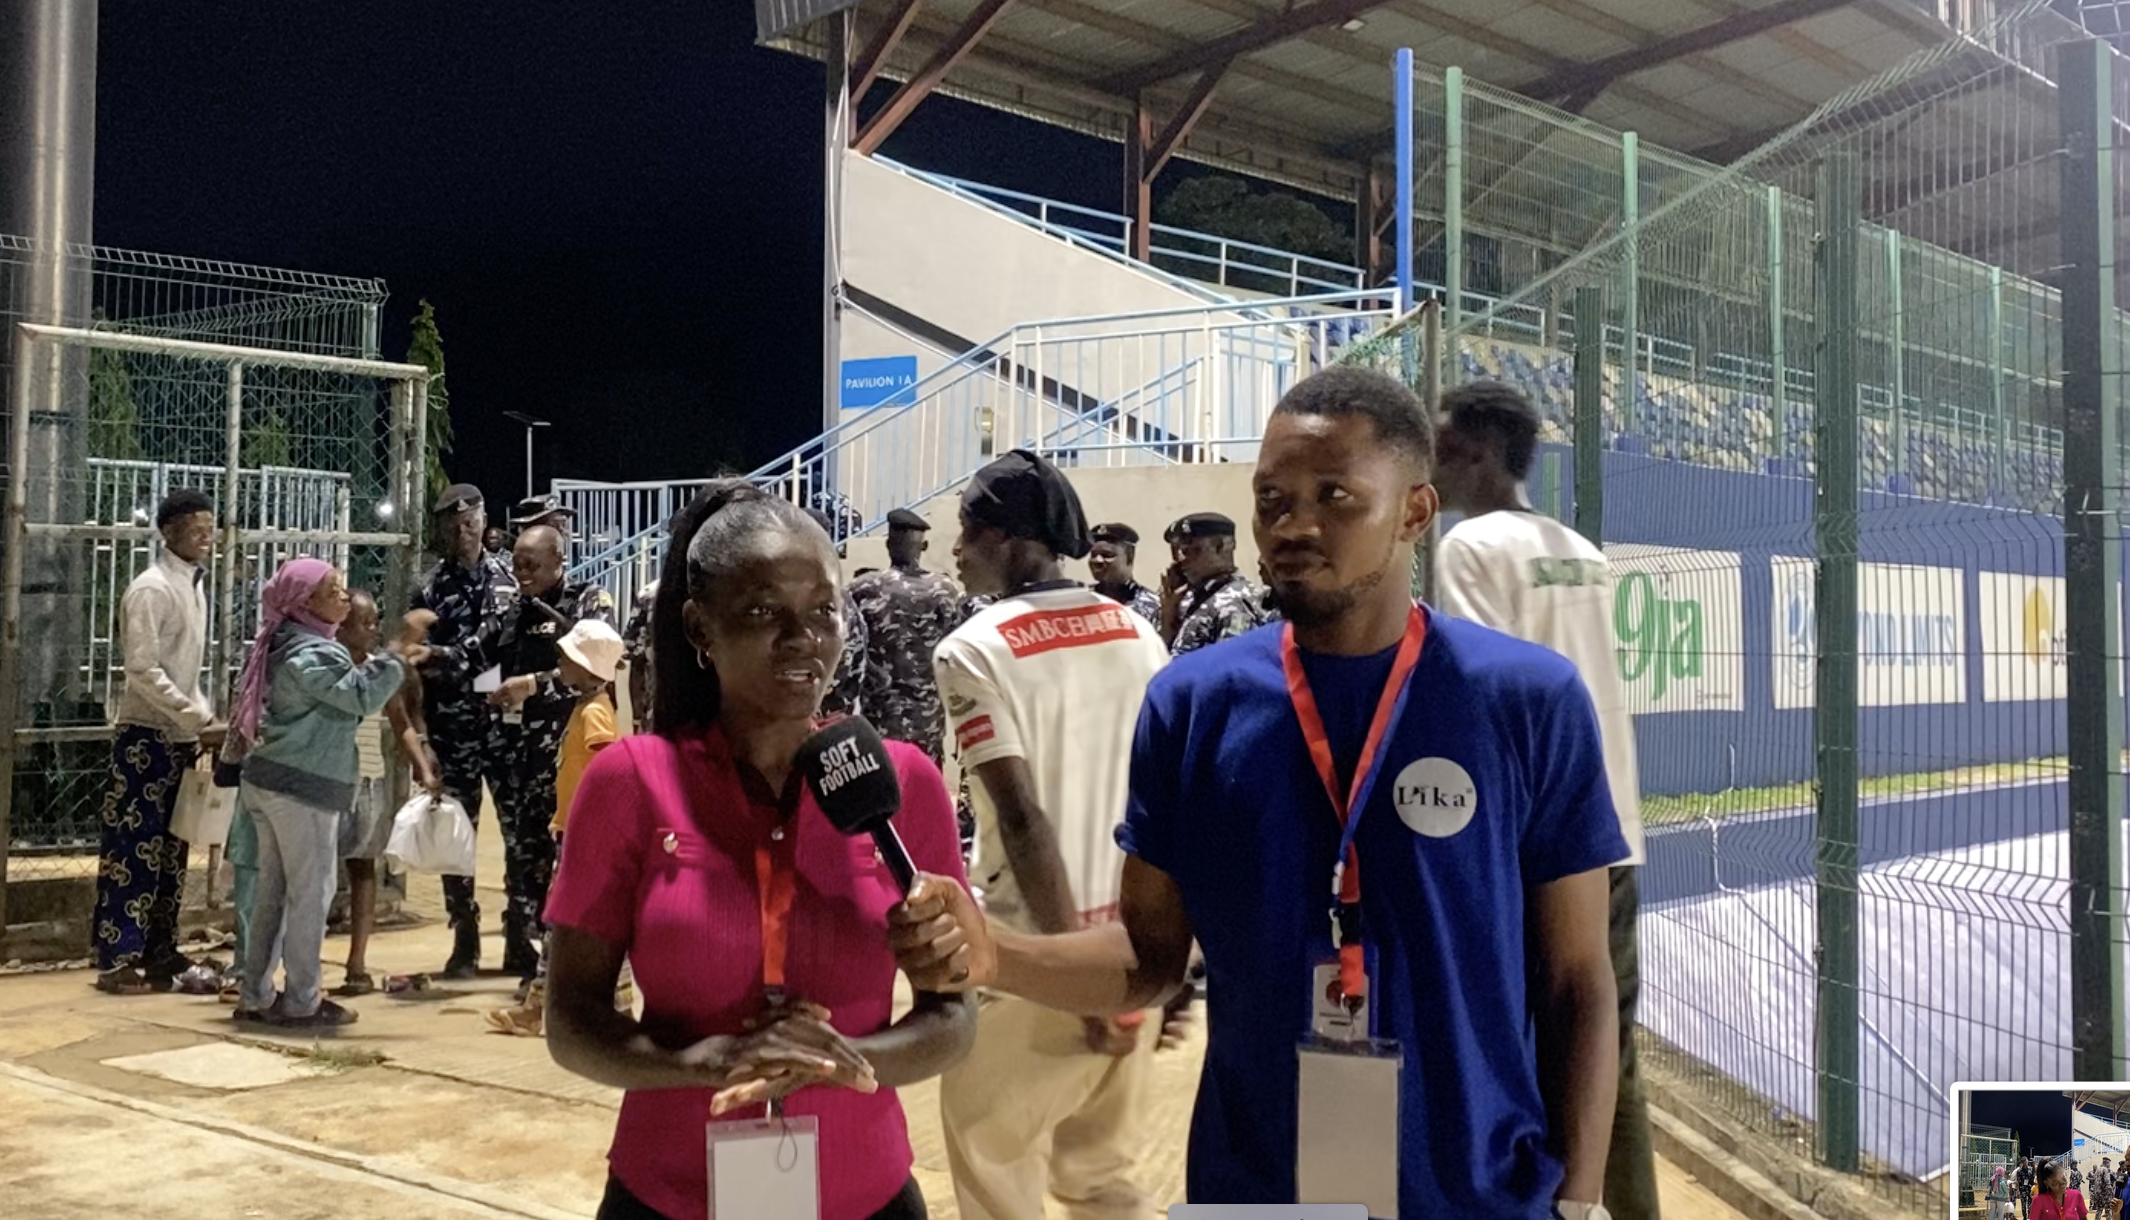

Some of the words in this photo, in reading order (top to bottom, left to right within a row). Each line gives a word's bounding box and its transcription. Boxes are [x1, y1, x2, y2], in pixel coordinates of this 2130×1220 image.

[845, 376, 894, 389] PAVILION
[1614, 571, 1703, 701] 9ja
[1858, 611, 1897, 667] OND
[820, 736, 859, 773] SOFT
[820, 753, 880, 797] FOOTBALL
